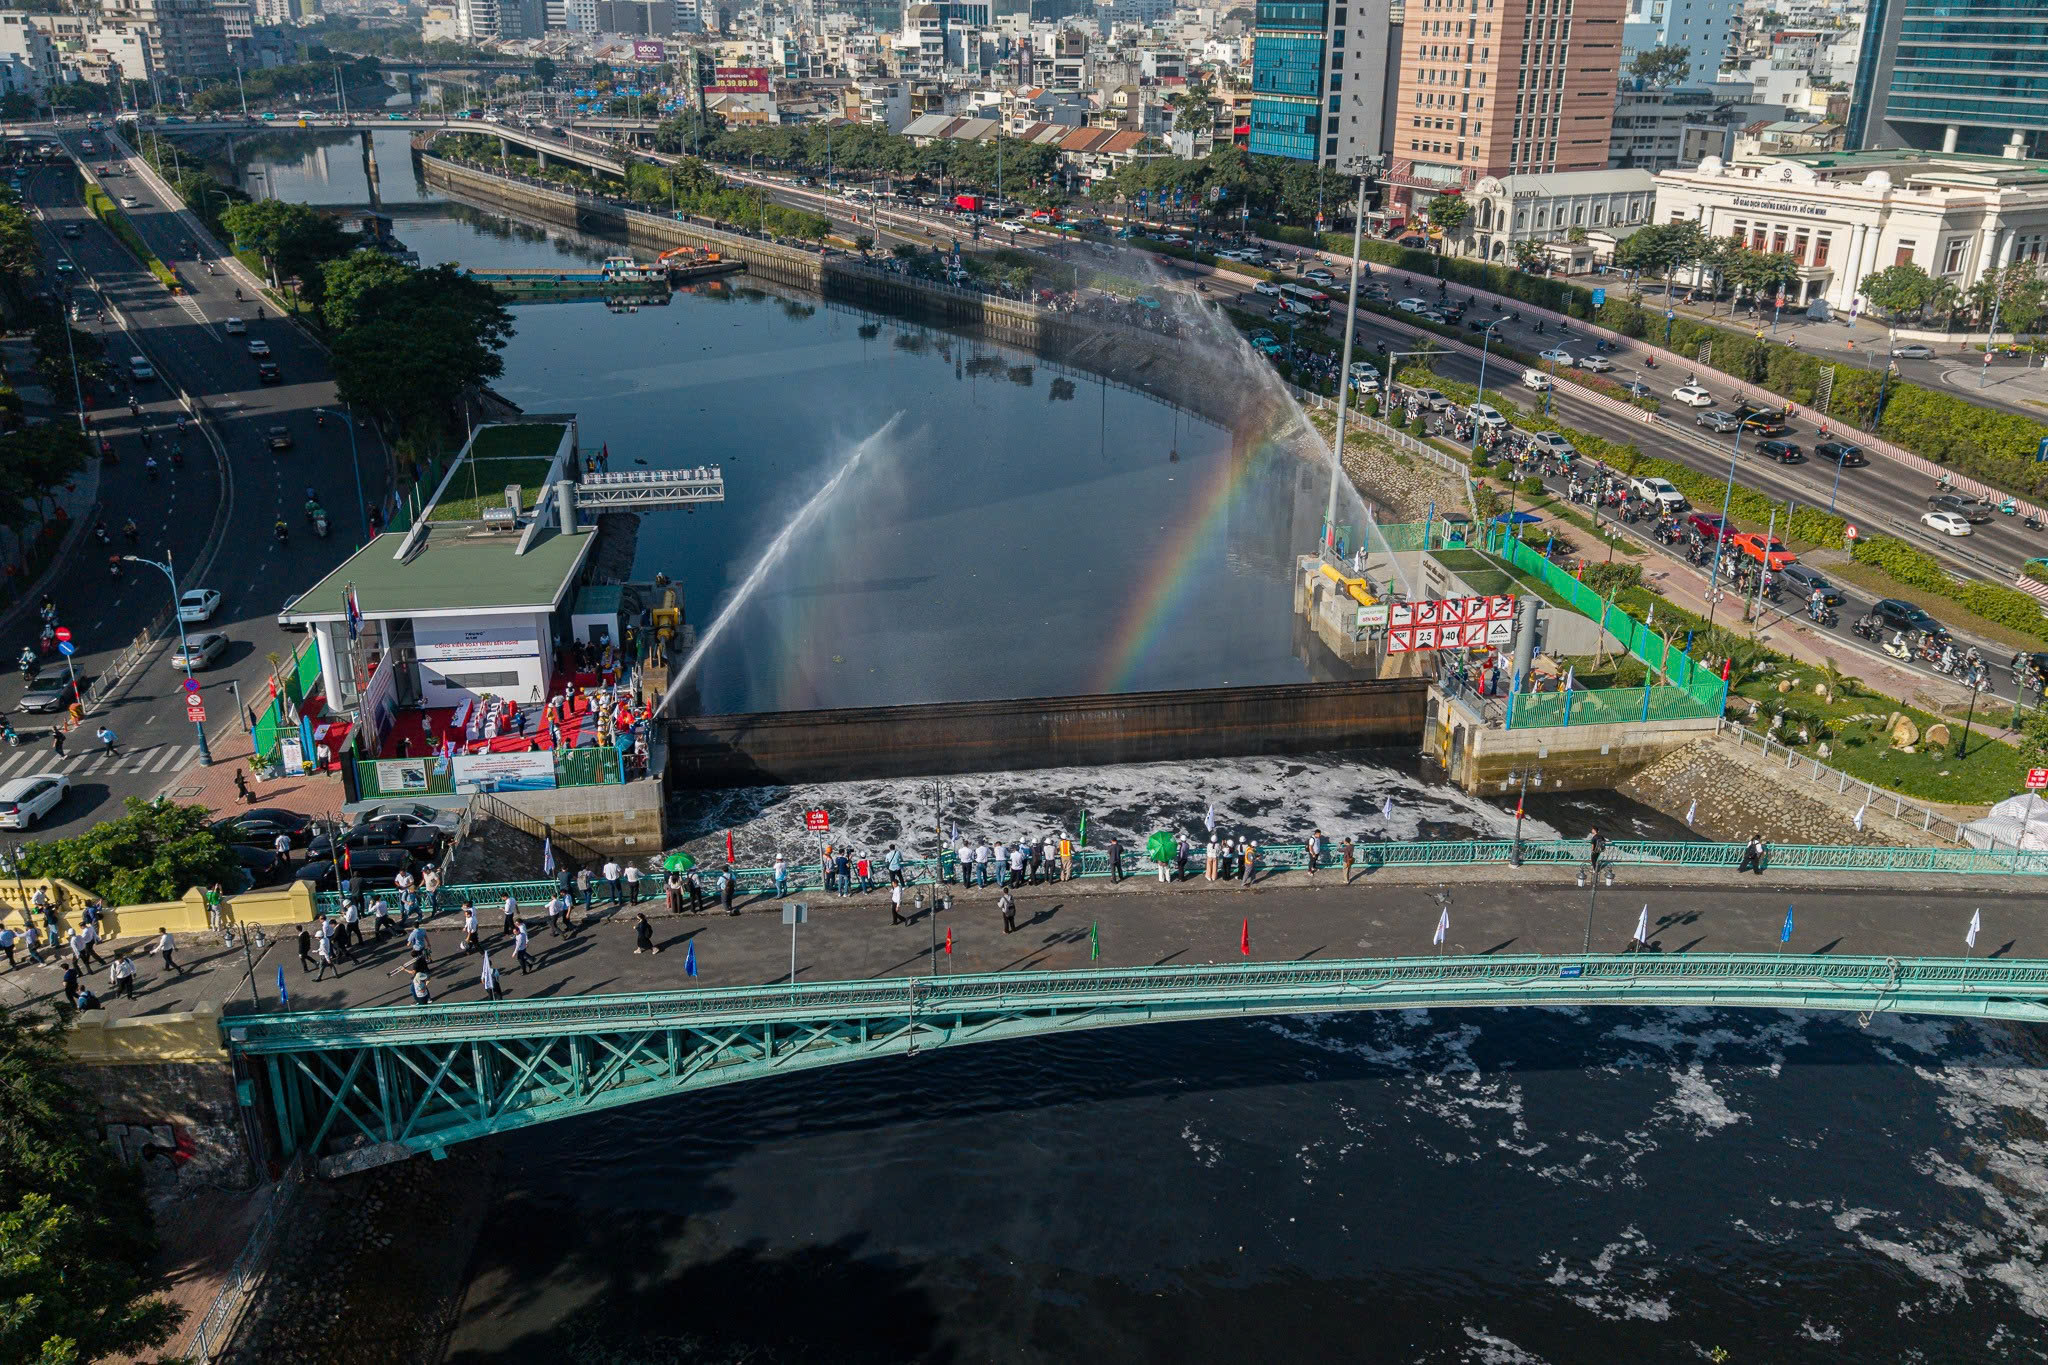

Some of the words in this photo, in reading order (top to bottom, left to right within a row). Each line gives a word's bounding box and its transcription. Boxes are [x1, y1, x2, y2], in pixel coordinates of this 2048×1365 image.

[638, 44, 657, 53] odoo
[1419, 631, 1432, 641] 2.5
[1445, 631, 1456, 640] 40
